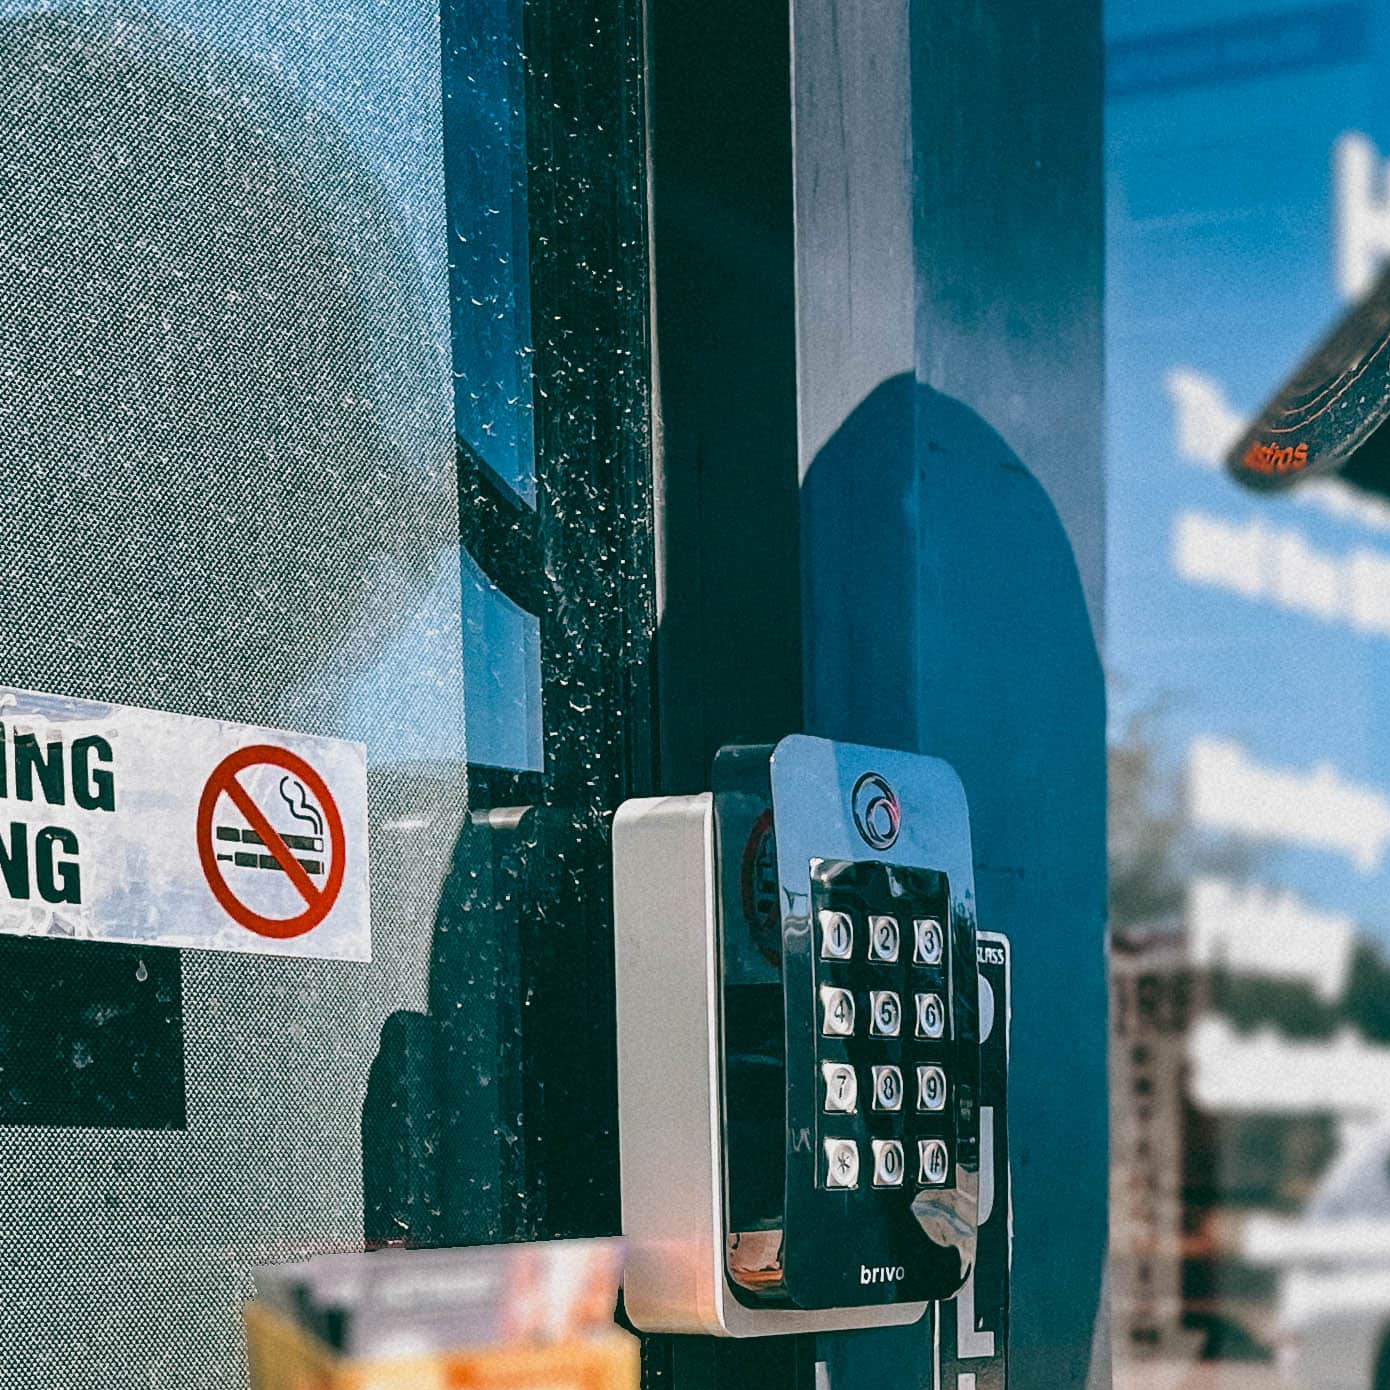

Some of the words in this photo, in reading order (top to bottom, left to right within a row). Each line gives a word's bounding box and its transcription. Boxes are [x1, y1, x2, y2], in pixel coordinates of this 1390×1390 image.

[879, 926, 891, 950] 2
[924, 930, 935, 953] 3
[834, 1000, 845, 1023] 4
[880, 1001, 892, 1025] 5
[925, 1003, 936, 1027] 6
[836, 1076, 847, 1099] 7
[884, 1075, 894, 1100] 8
[927, 1077, 938, 1102] 9
[885, 1150, 894, 1174] 0
[860, 1265, 905, 1285] brivo
